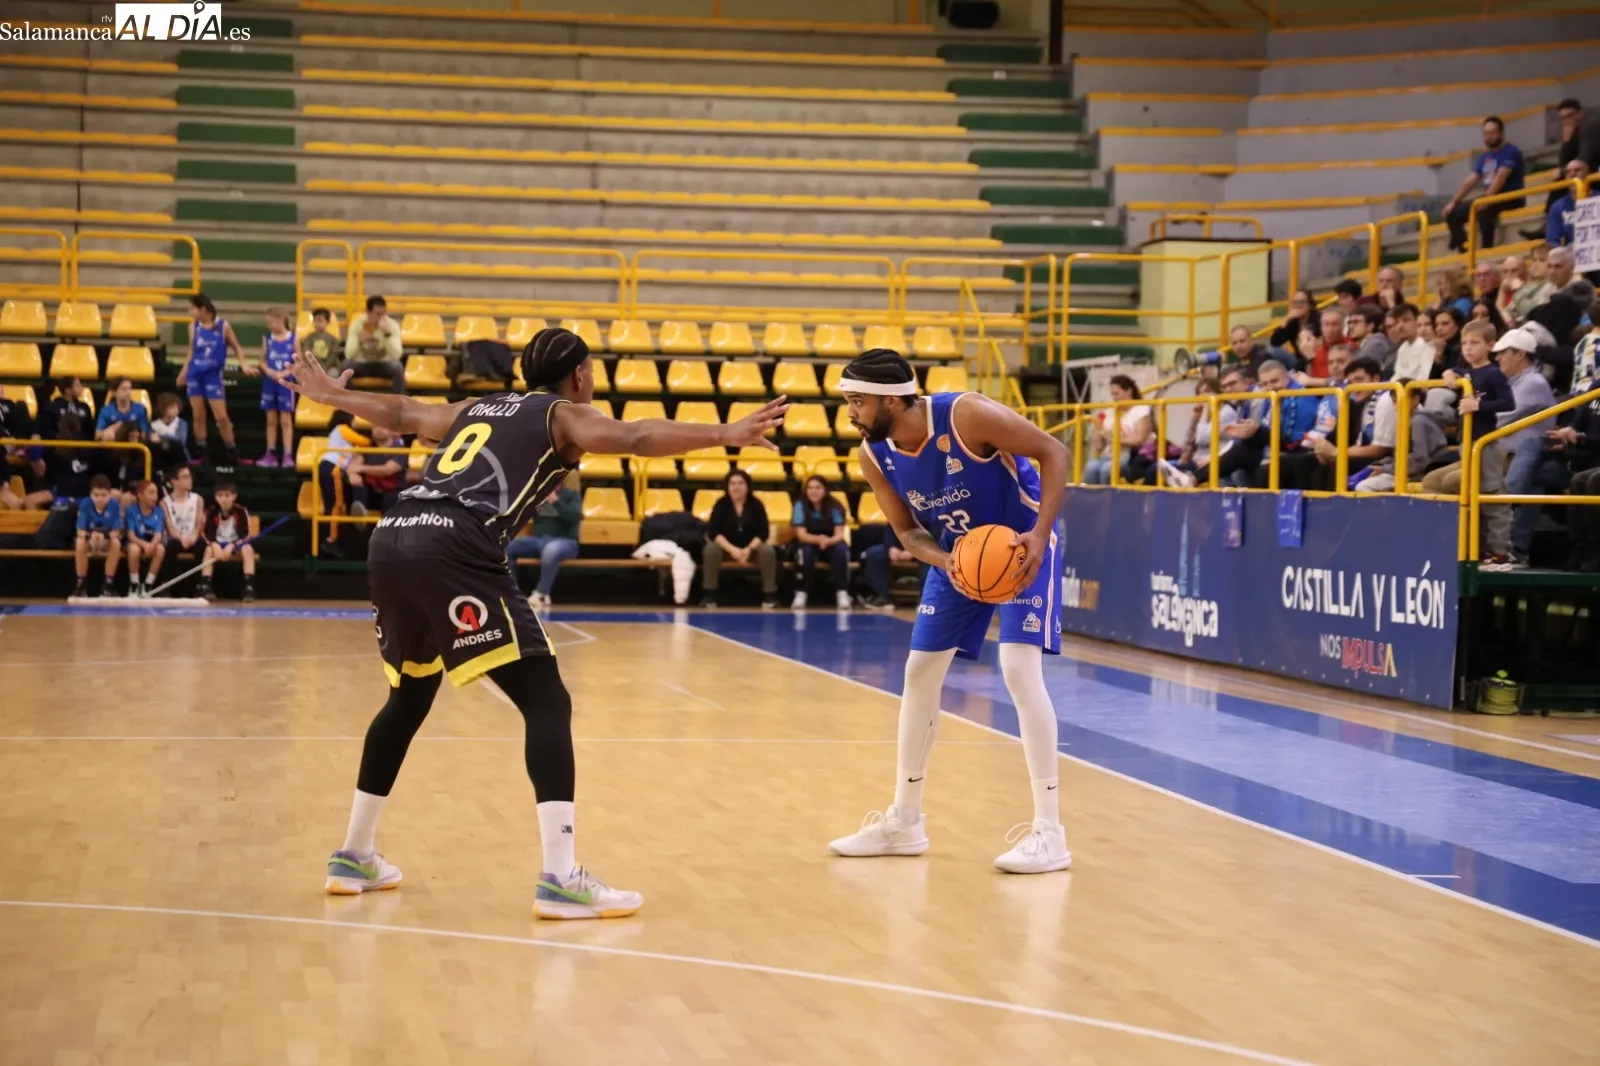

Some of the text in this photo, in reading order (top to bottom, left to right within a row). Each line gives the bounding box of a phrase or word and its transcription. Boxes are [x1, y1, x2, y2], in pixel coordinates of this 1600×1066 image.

[467, 403, 521, 417] DIALLO
[437, 422, 492, 474] 0
[1282, 560, 1446, 632] CASTILLA Y LEÓN
[1320, 633, 1341, 660] NOS
